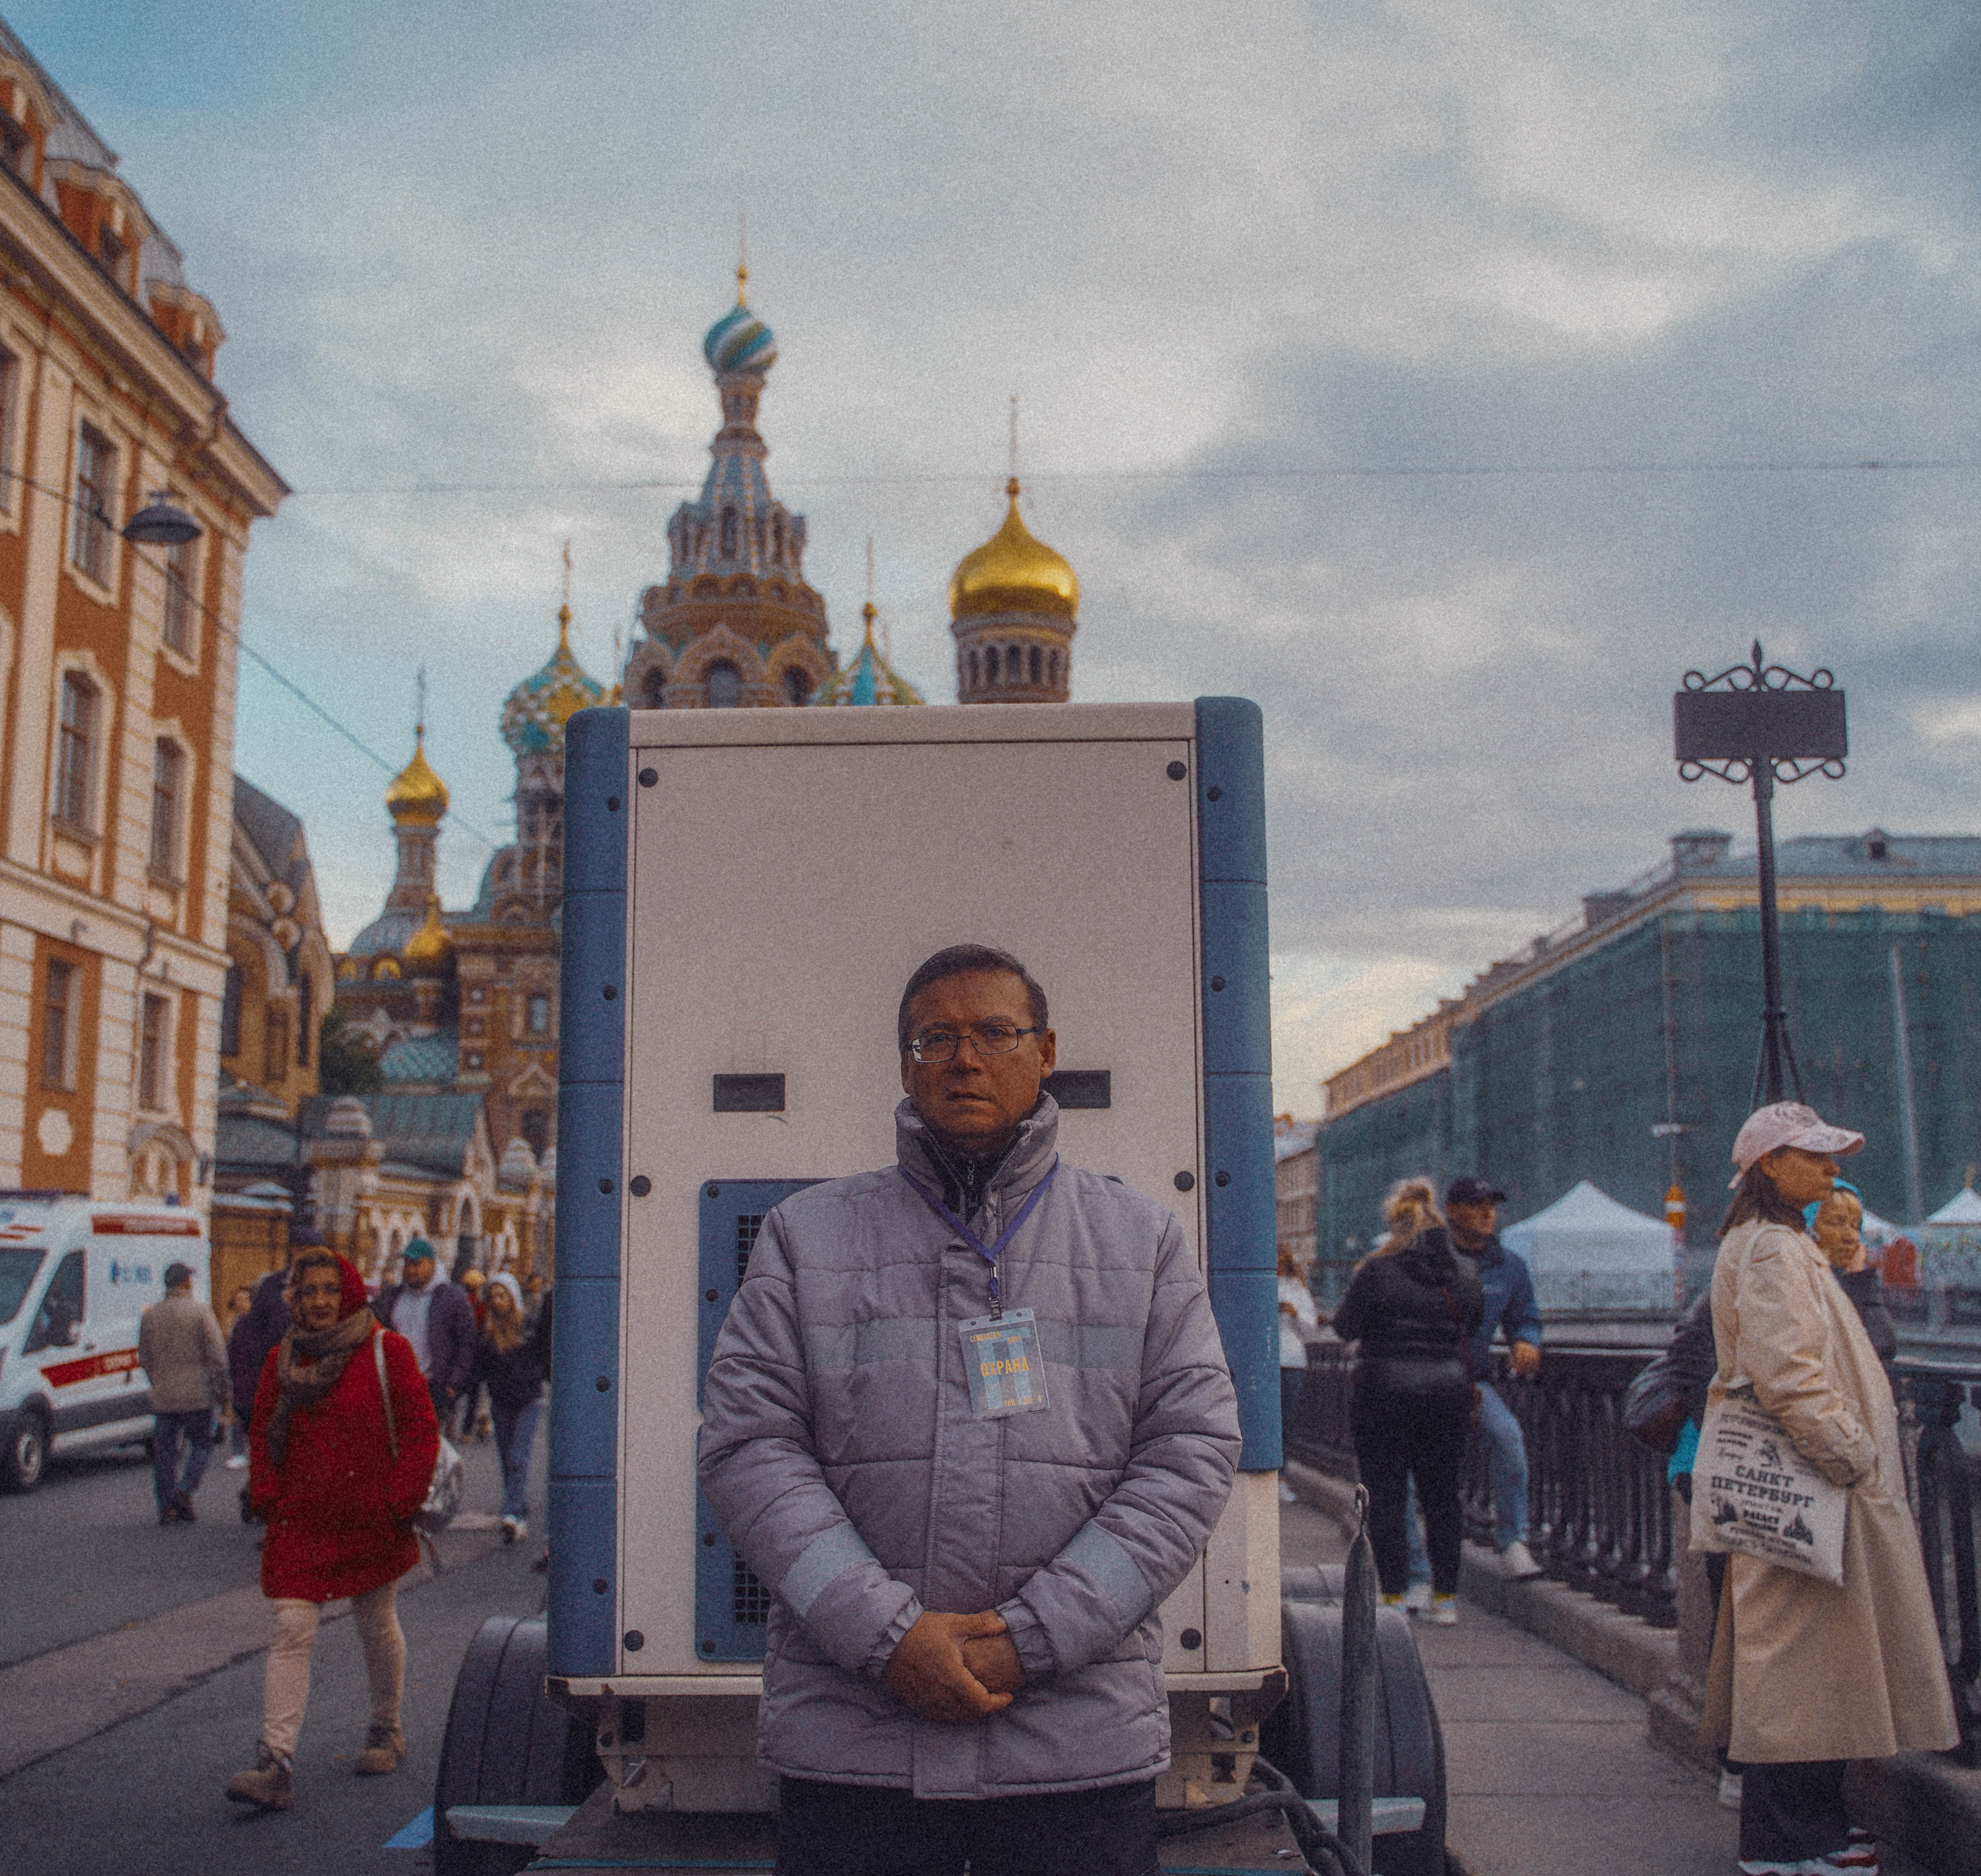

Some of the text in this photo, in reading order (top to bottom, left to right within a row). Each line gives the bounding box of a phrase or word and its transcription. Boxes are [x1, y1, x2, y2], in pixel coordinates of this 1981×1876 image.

[980, 1357, 1030, 1377] ОХРАНА
[1735, 1465, 1794, 1487] САНКТ
[1712, 1476, 1815, 1508] ПЕТЕРБУРГ
